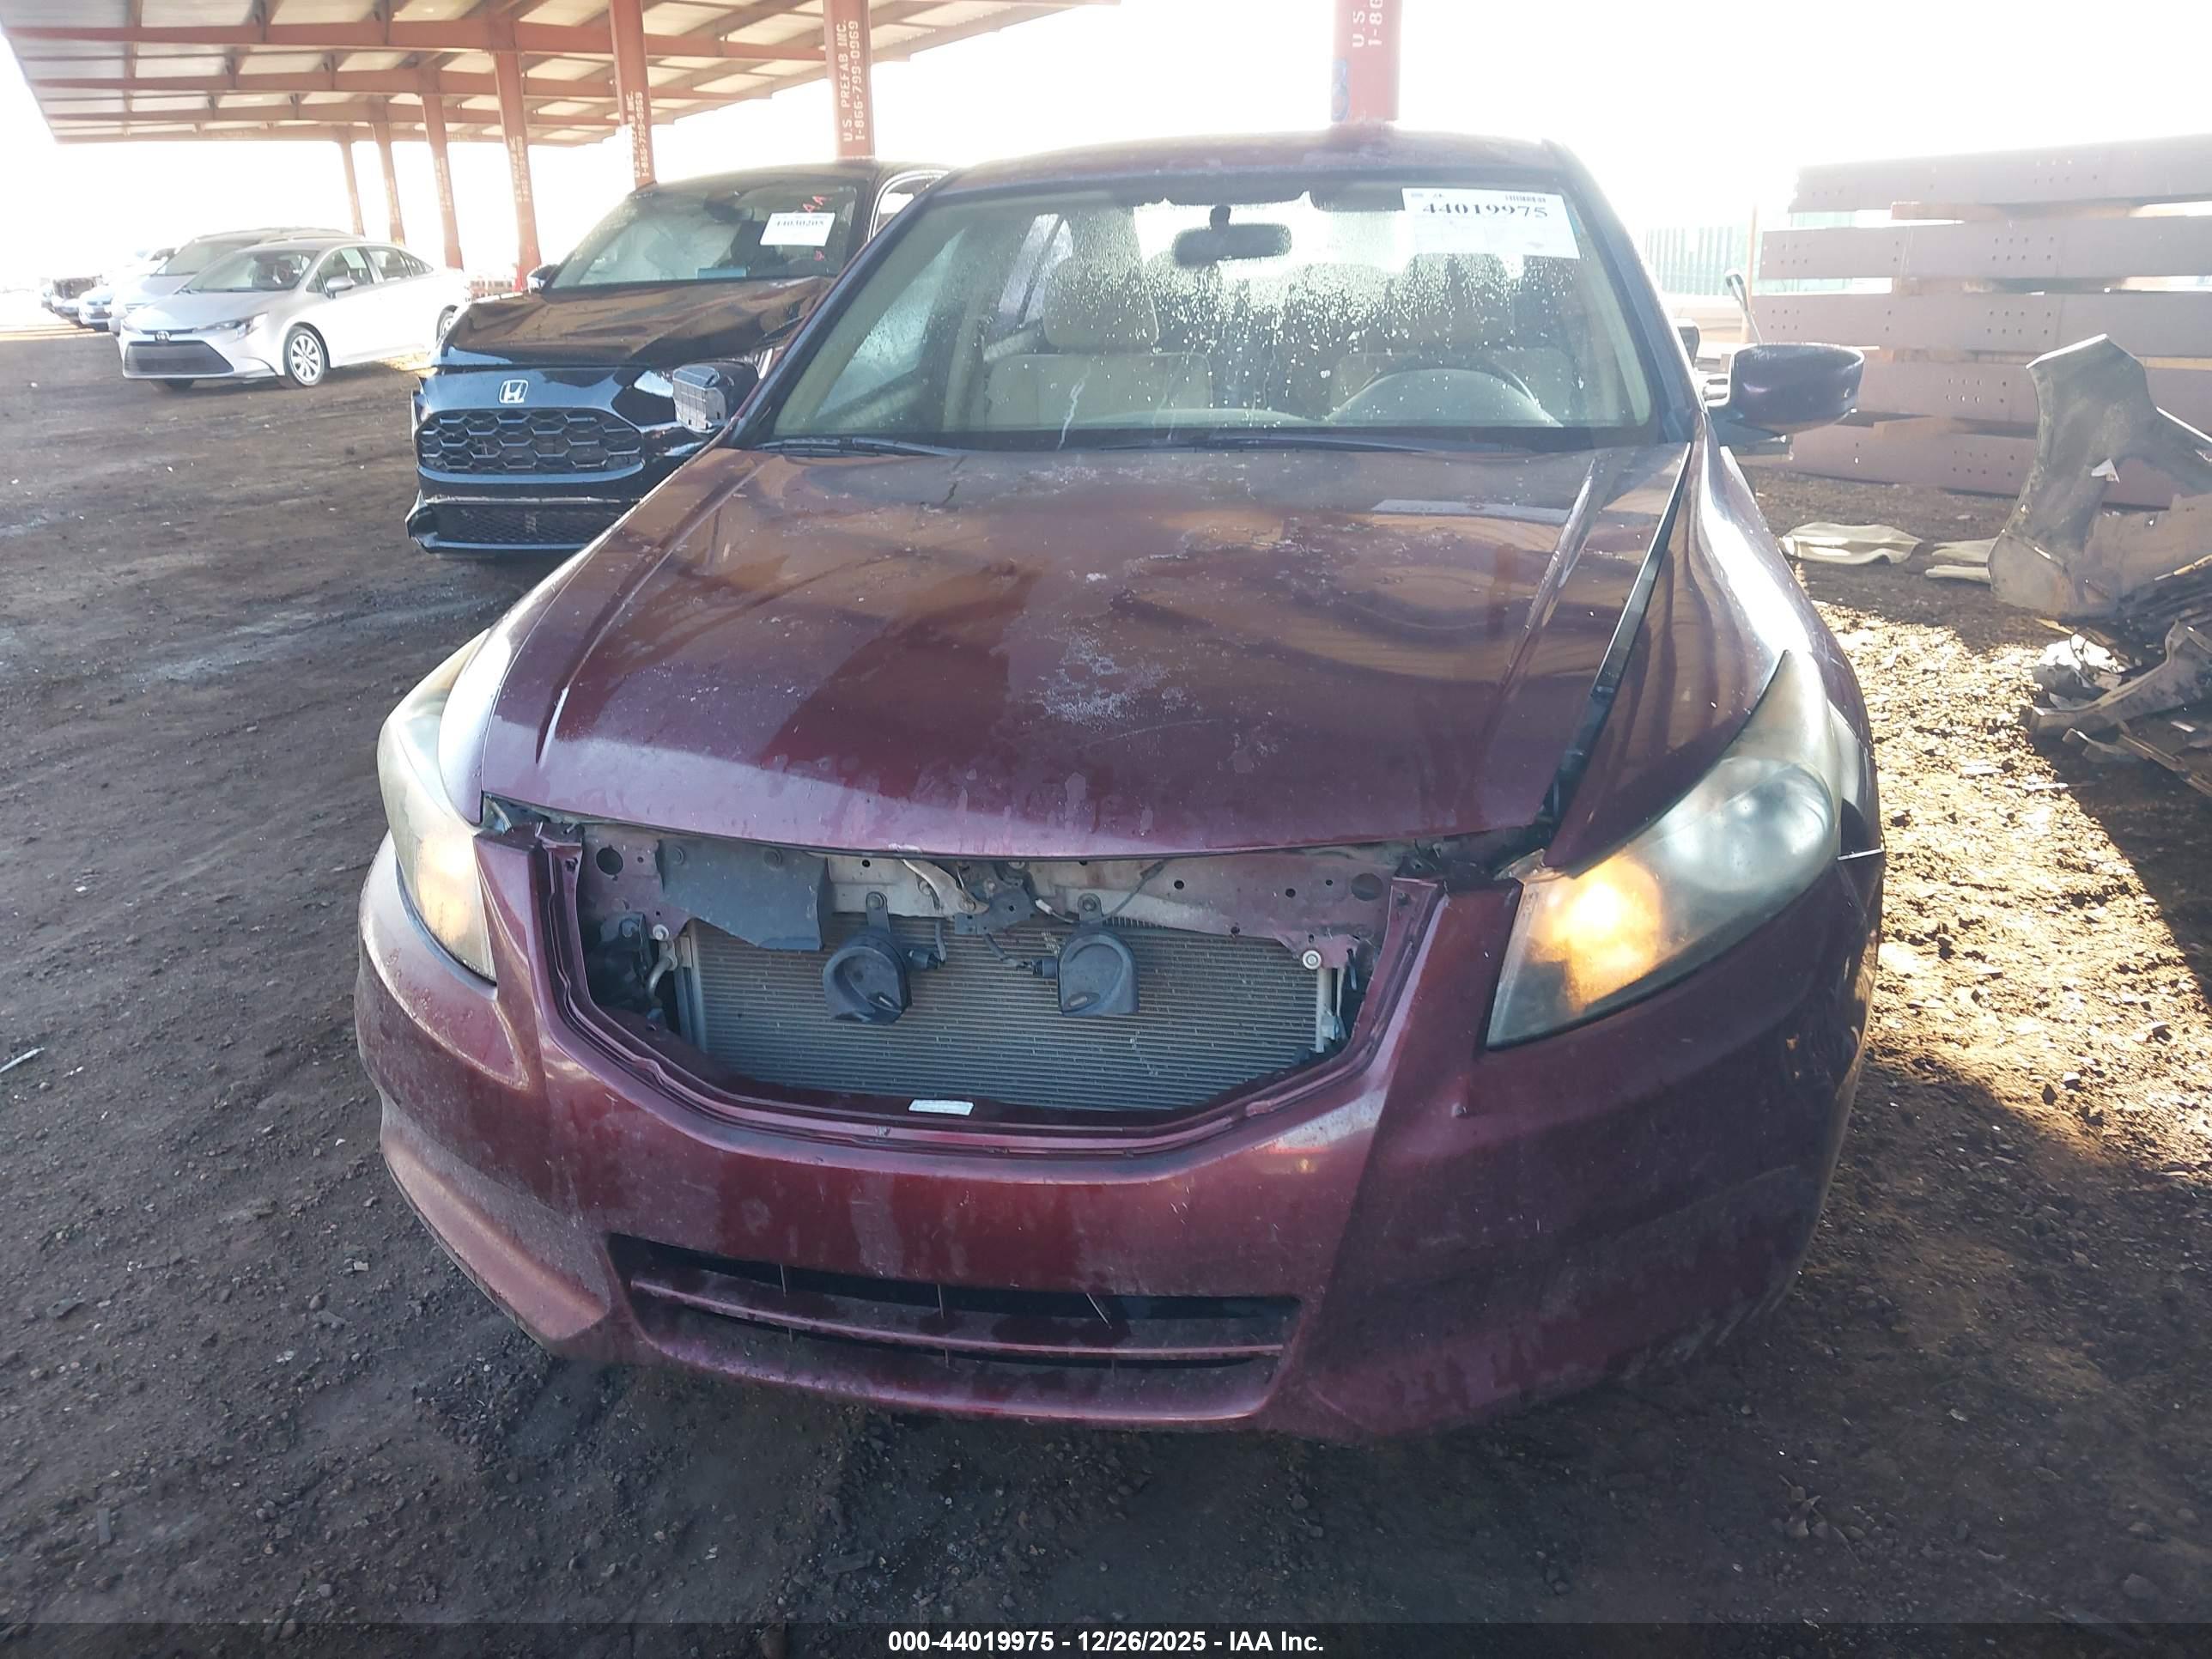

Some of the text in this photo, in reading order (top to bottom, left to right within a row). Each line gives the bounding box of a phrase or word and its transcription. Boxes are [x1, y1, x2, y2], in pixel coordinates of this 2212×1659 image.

[836, 19, 848, 47] INC.
[837, 52, 851, 108] PREFAB
[848, 20, 866, 142] 1-866-799-0969
[1422, 203, 1548, 219] 44019975
